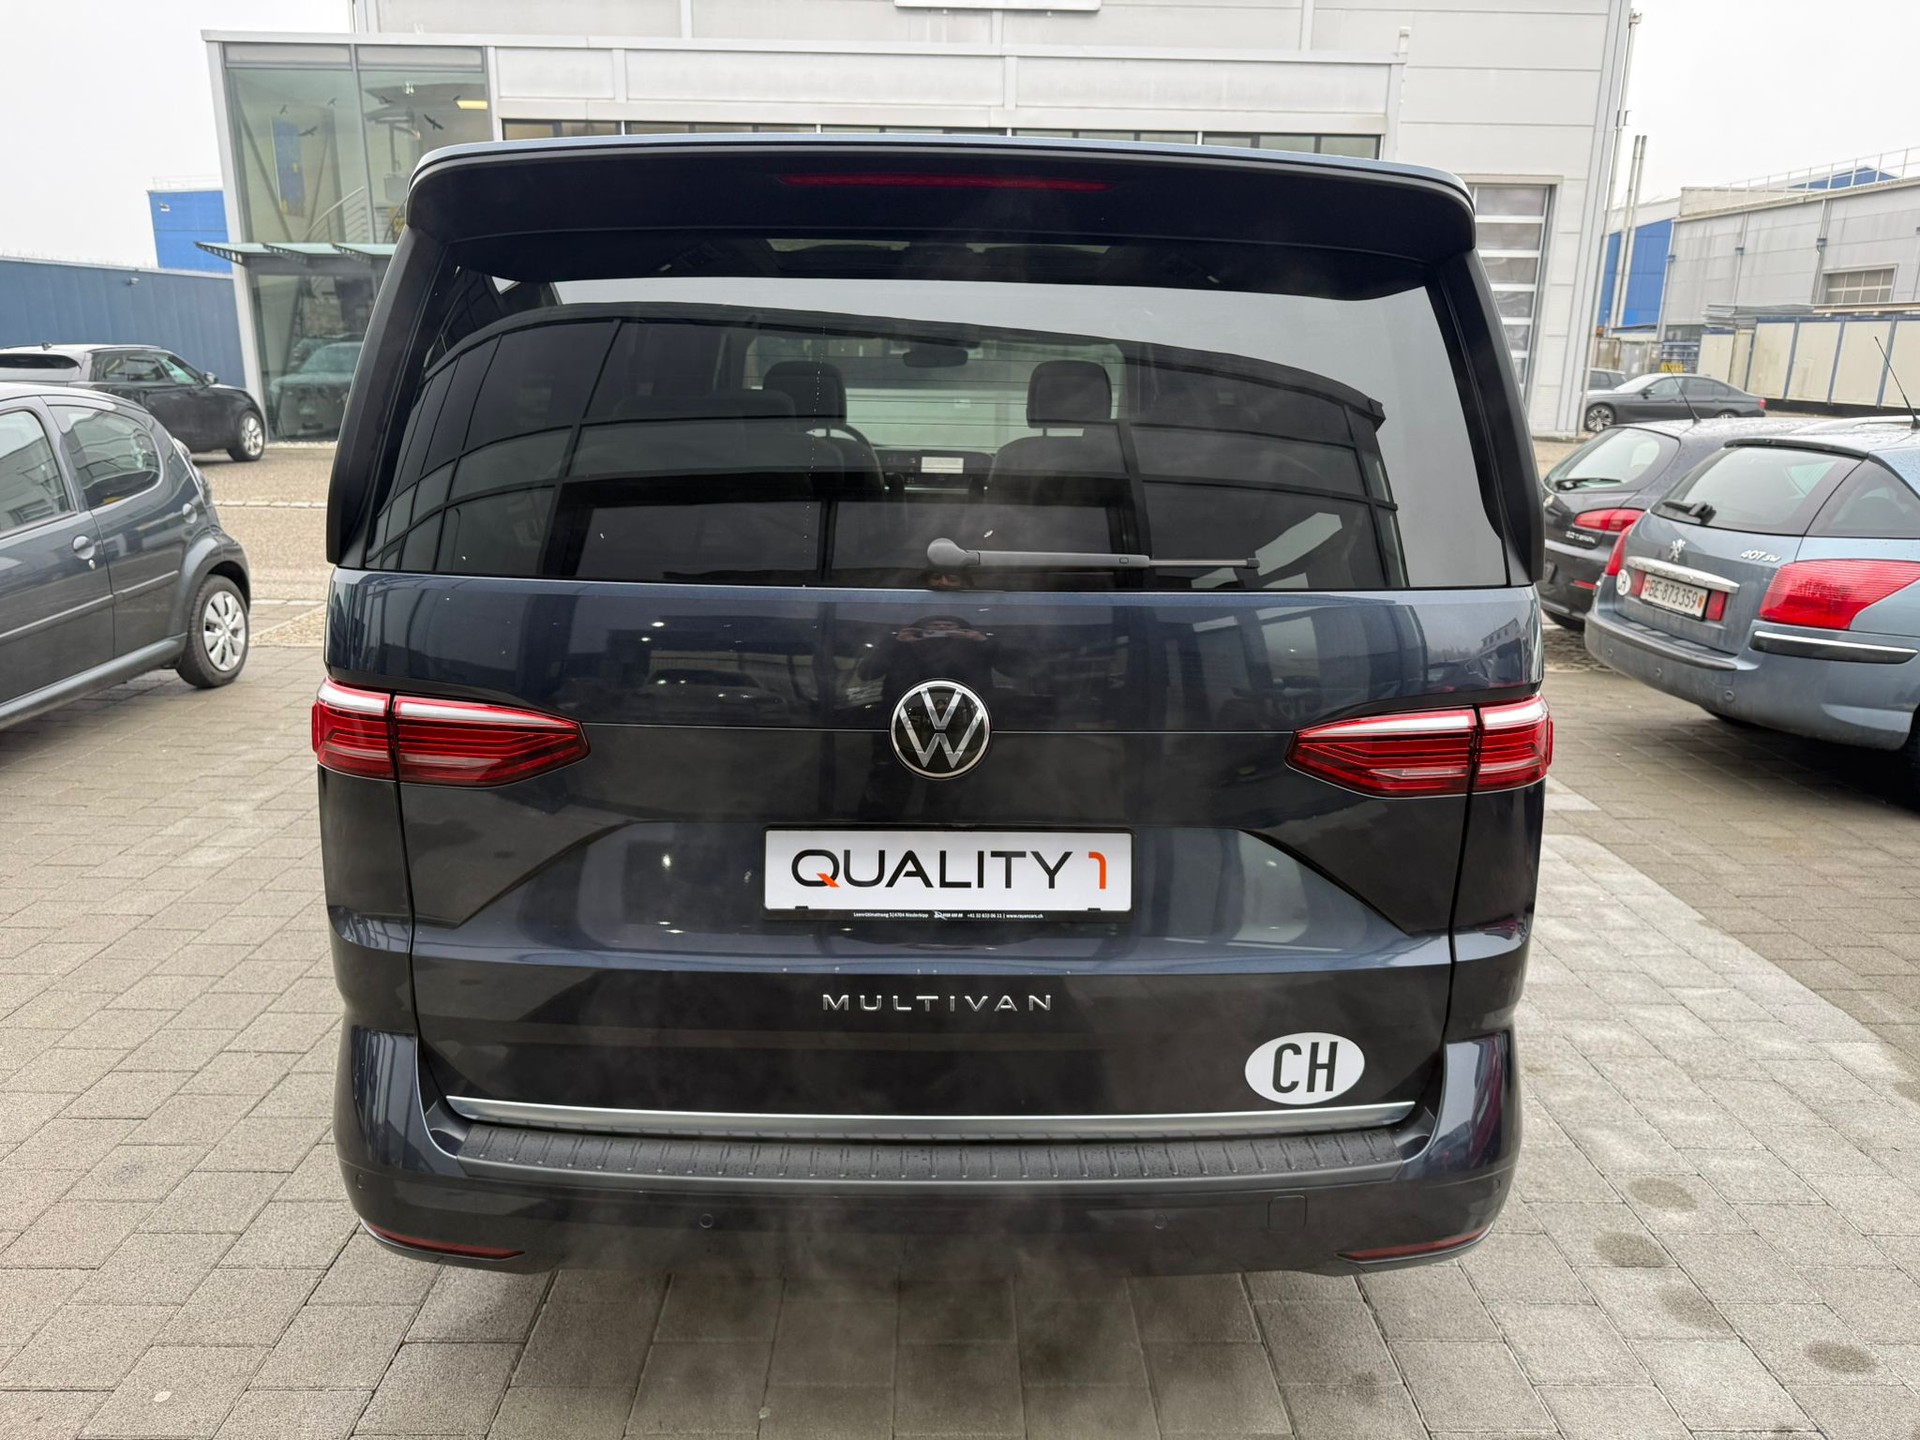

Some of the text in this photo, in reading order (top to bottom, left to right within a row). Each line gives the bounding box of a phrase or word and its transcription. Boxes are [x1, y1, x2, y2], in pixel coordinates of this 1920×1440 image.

[1740, 549, 1767, 561] 407
[893, 682, 988, 775] VW
[791, 848, 1107, 890] QUALITY 1
[822, 994, 1051, 1012] MULTIVAN
[1272, 1041, 1338, 1094] CH
